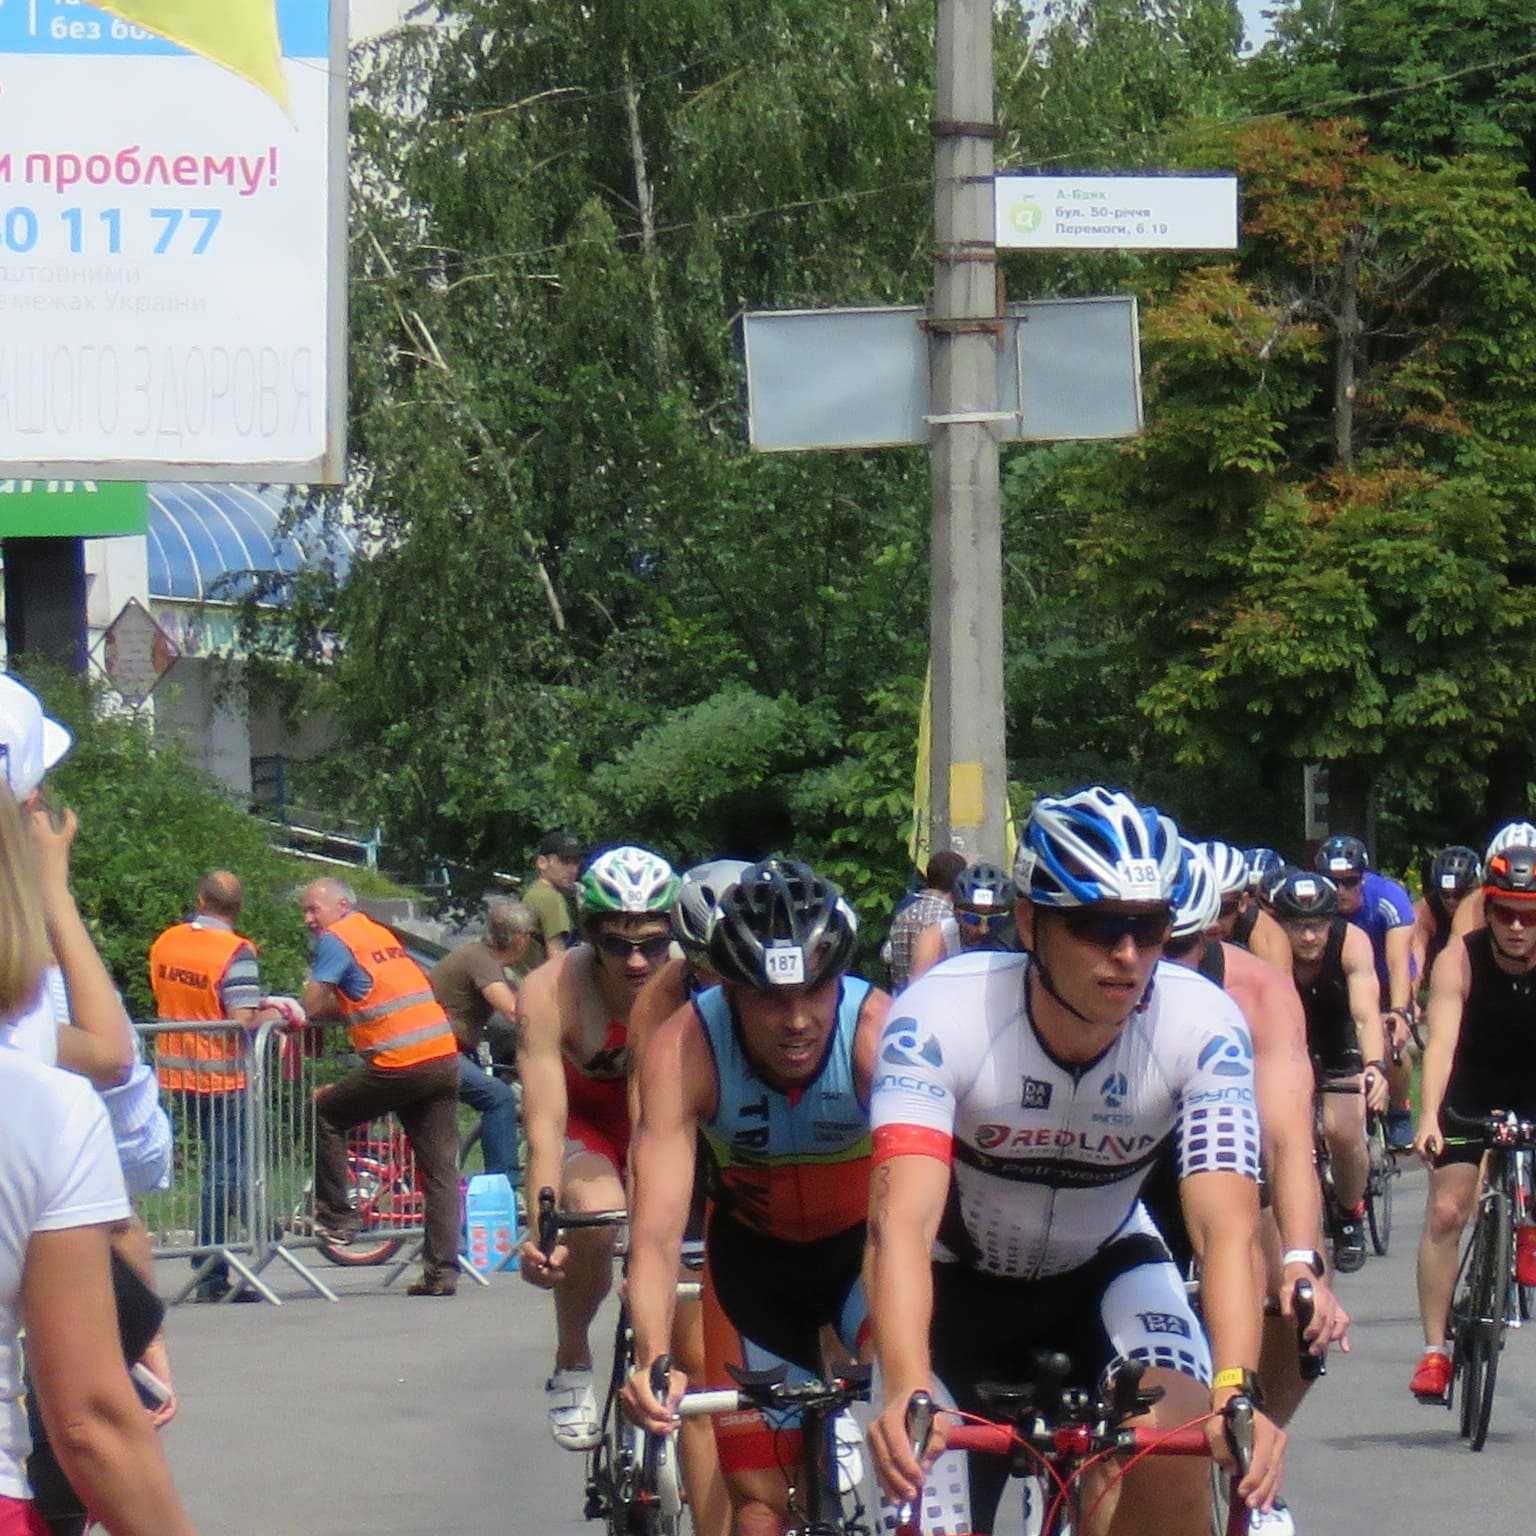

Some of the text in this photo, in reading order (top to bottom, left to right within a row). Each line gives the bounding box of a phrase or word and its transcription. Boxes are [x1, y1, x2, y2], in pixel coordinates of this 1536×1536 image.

[51, 16, 101, 40] без
[25, 146, 279, 196] проблему!
[61, 207, 122, 253] 11
[150, 208, 223, 255] 77
[1125, 865, 1157, 883] 138
[769, 954, 798, 972] 187
